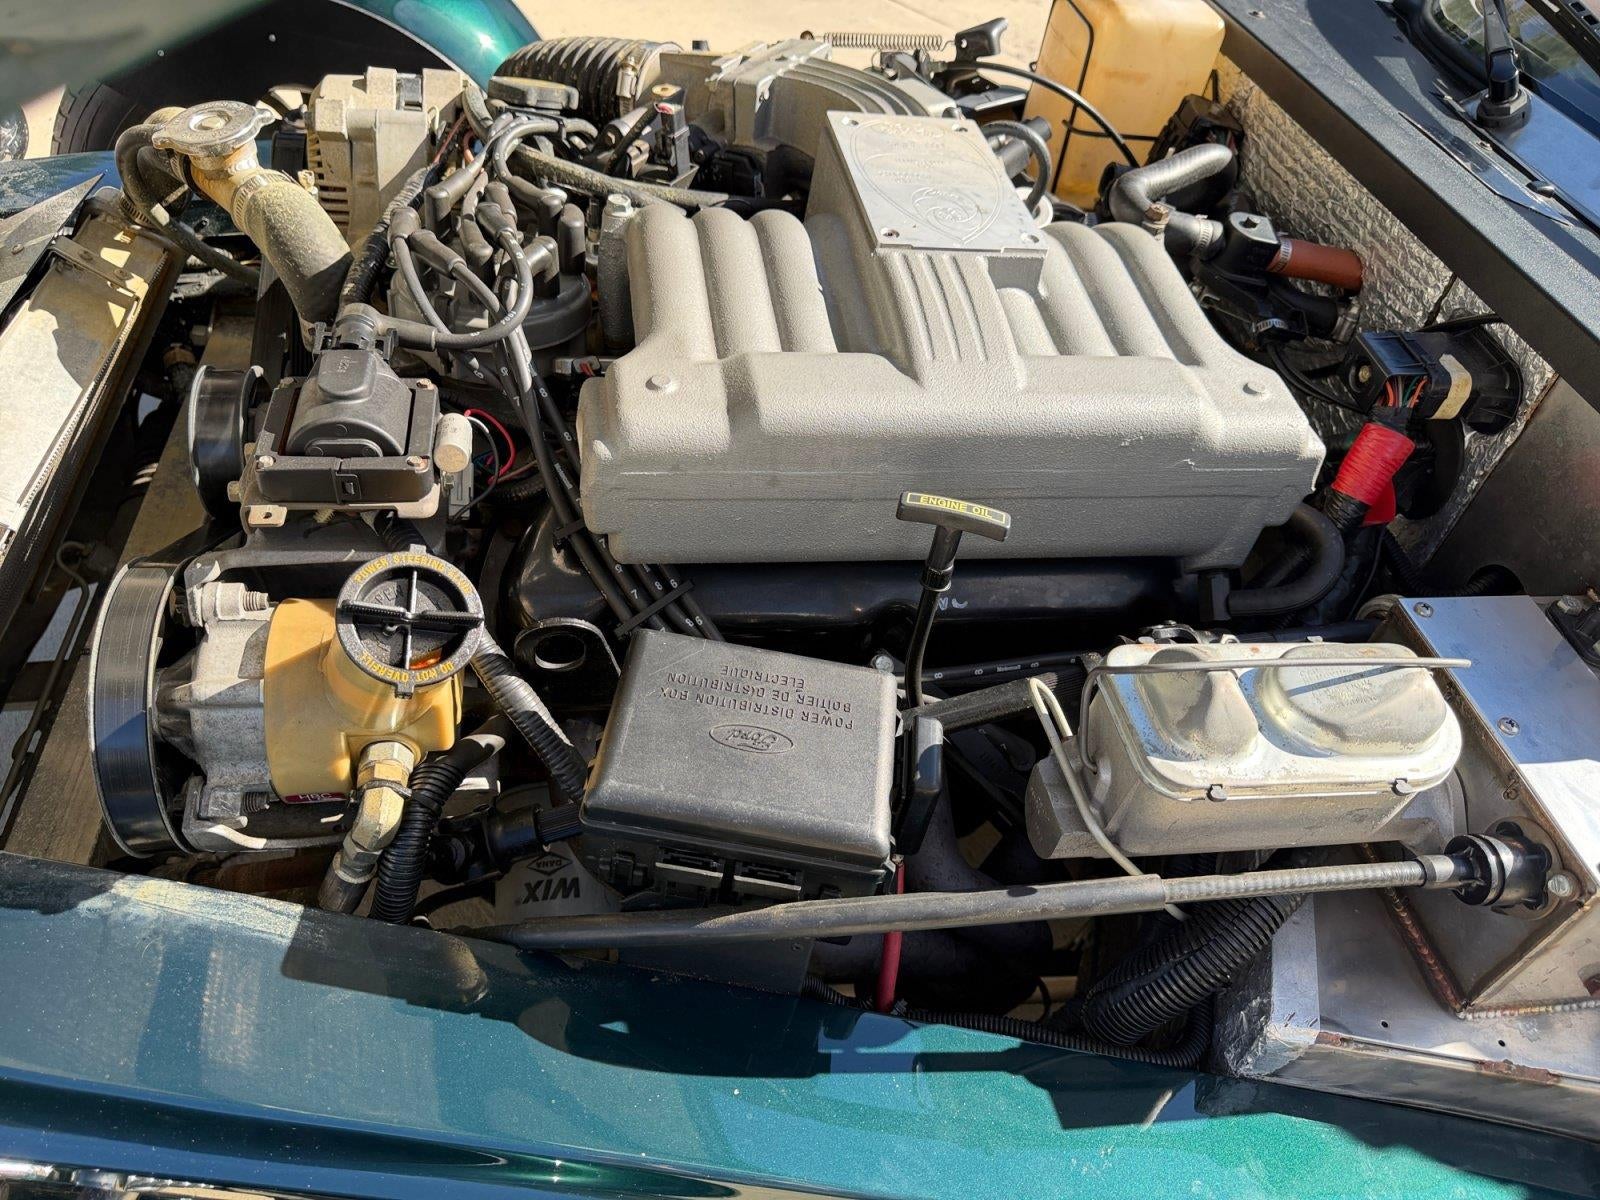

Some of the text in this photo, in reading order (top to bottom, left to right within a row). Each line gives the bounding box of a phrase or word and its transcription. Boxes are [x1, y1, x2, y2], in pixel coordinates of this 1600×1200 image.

[540, 388, 548, 398] 8
[563, 431, 572, 441] 8
[920, 496, 993, 519] ENGINE OIL
[354, 558, 389, 584] POWER
[392, 554, 445, 571] STEERING
[654, 581, 663, 591] 8
[670, 579, 678, 589] 6
[631, 589, 638, 599] 7
[685, 618, 694, 627] 8
[695, 616, 703, 626] 6
[361, 650, 454, 683] DO NOT OVERFILL
[667, 672, 765, 697] DISTRIBUTION
[772, 690, 790, 702] DE
[660, 686, 853, 730] POWER DISTRIBUTION BOX
[725, 728, 777, 750] Ford
[535, 860, 562, 868] DANA
[522, 877, 580, 904] WIX
